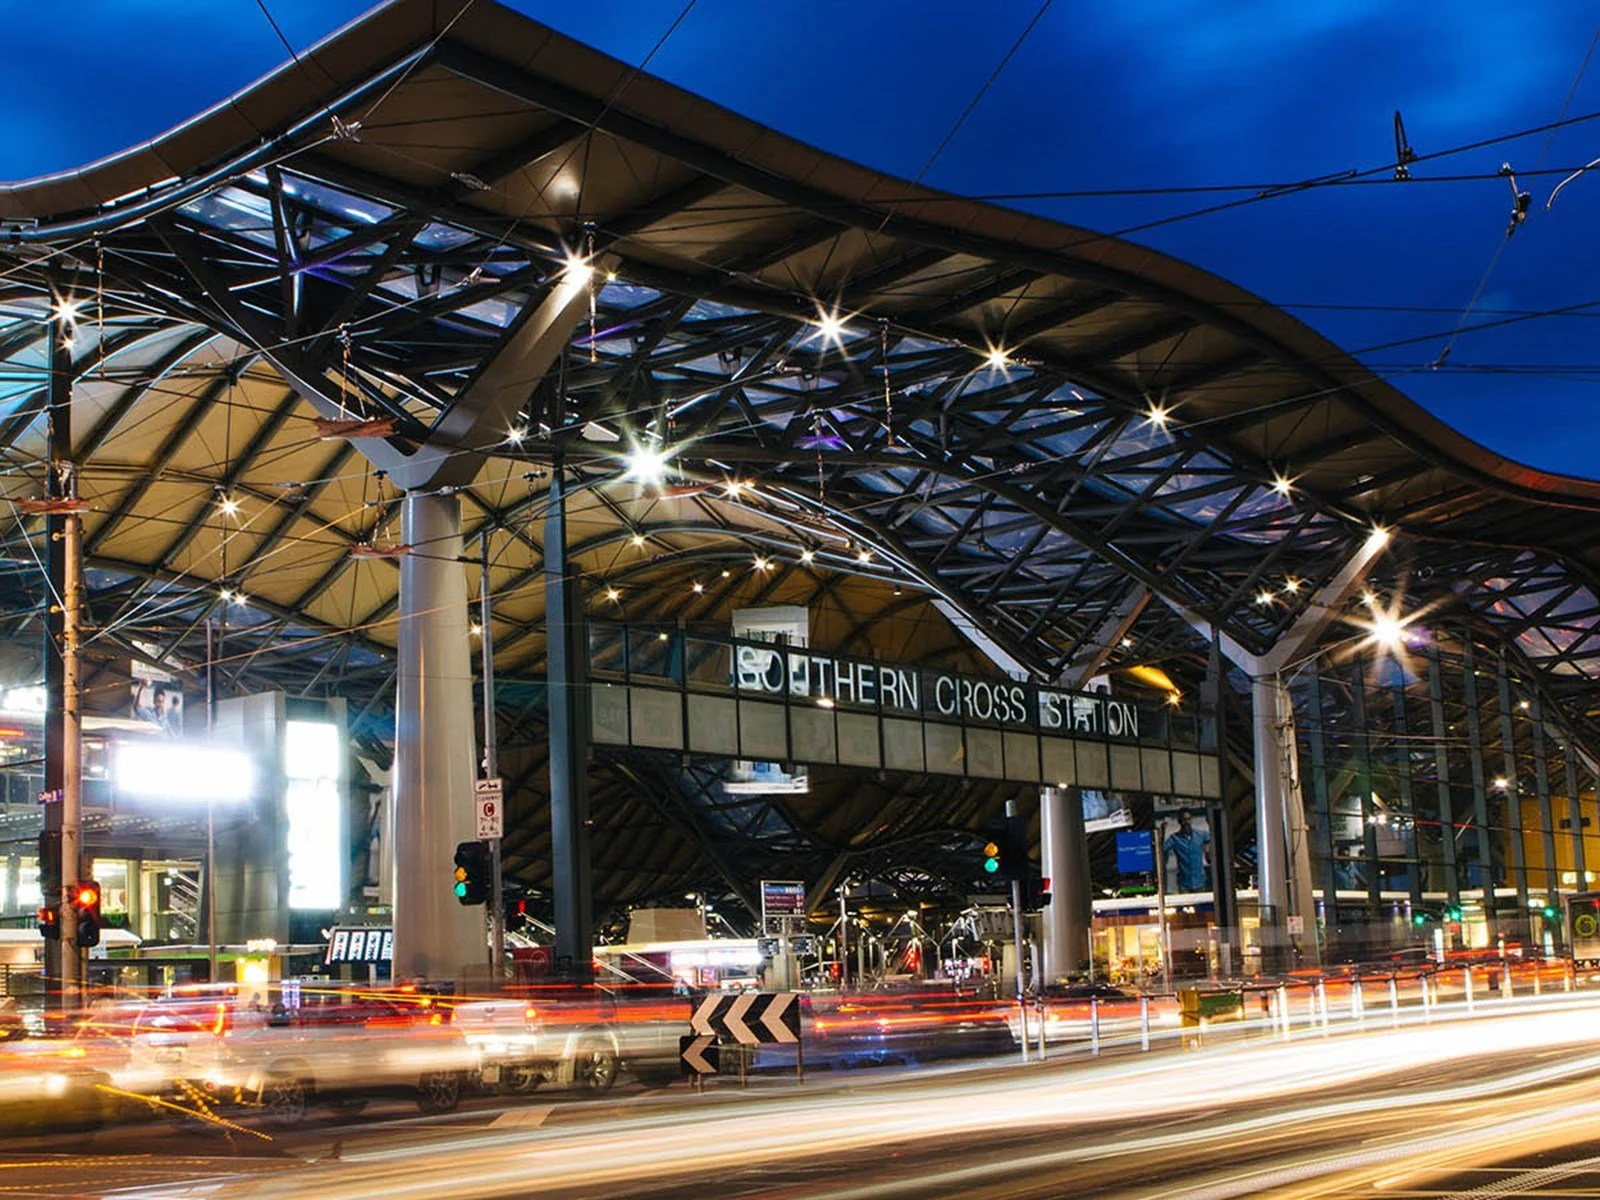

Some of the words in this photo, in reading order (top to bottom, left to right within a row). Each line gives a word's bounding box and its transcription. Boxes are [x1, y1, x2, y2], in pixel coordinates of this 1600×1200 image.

[739, 646, 916, 709] SOUTHERN
[936, 675, 1026, 723] CROSS
[1046, 692, 1138, 737] STATION
